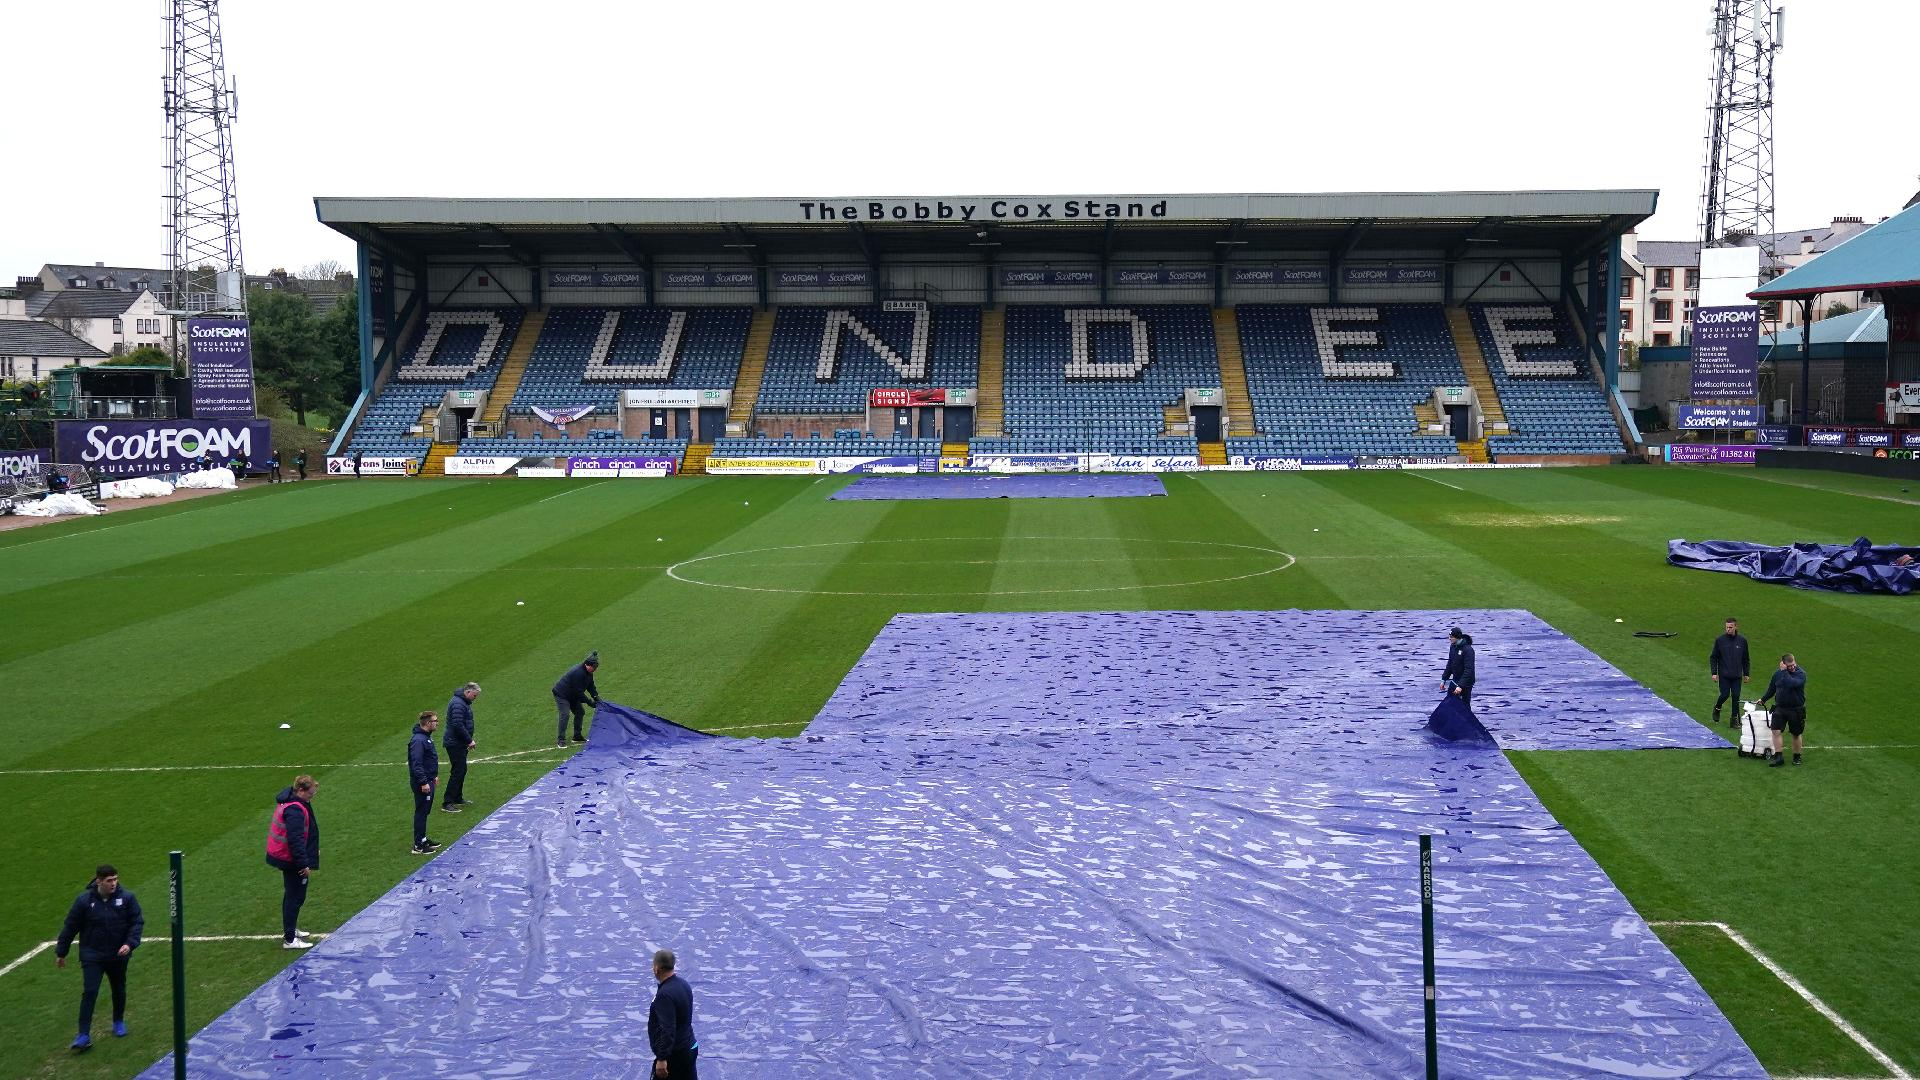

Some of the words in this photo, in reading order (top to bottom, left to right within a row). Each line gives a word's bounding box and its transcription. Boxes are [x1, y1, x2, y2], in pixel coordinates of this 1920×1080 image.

[801, 202, 858, 220] The
[868, 203, 976, 222] Bobby
[991, 200, 1052, 218] Cox
[1063, 200, 1167, 218] Stand
[554, 274, 592, 282] ScotFOAM
[602, 274, 639, 282] ScotFOAM
[667, 274, 704, 282] ScotFOAM
[715, 274, 752, 282] ScotFOAM
[781, 273, 818, 282] ScotFOAM
[829, 273, 866, 282] ScotFOAM
[1006, 272, 1044, 280] ScotFOAM
[1055, 272, 1092, 280] ScotFOAM
[1120, 272, 1158, 280] ScotFOAM
[1169, 271, 1206, 280] ScotFOAM
[1236, 271, 1273, 280] ScotFOAM
[1284, 271, 1321, 279] ScotFOAM
[1350, 270, 1387, 279] ScotFOAM
[1398, 270, 1436, 278] ScotFOAM
[1697, 310, 1756, 323] ScotFOAM
[191, 326, 246, 337] ScotFOAM
[1693, 408, 1726, 416] Welcome
[1737, 408, 1750, 416] the
[1685, 415, 1730, 426] ScotFOAM
[1811, 433, 1841, 441] ScotFOAM
[1859, 434, 1888, 442] ScotFOAM
[81, 425, 250, 462] ScotFOAM
[1720, 450, 1742, 458] 01382
[573, 459, 600, 468] cinch
[609, 459, 635, 468] cinch
[645, 459, 671, 468] cinch
[1248, 457, 1301, 468] ScotFOAM
[1423, 860, 1431, 899] HARROD
